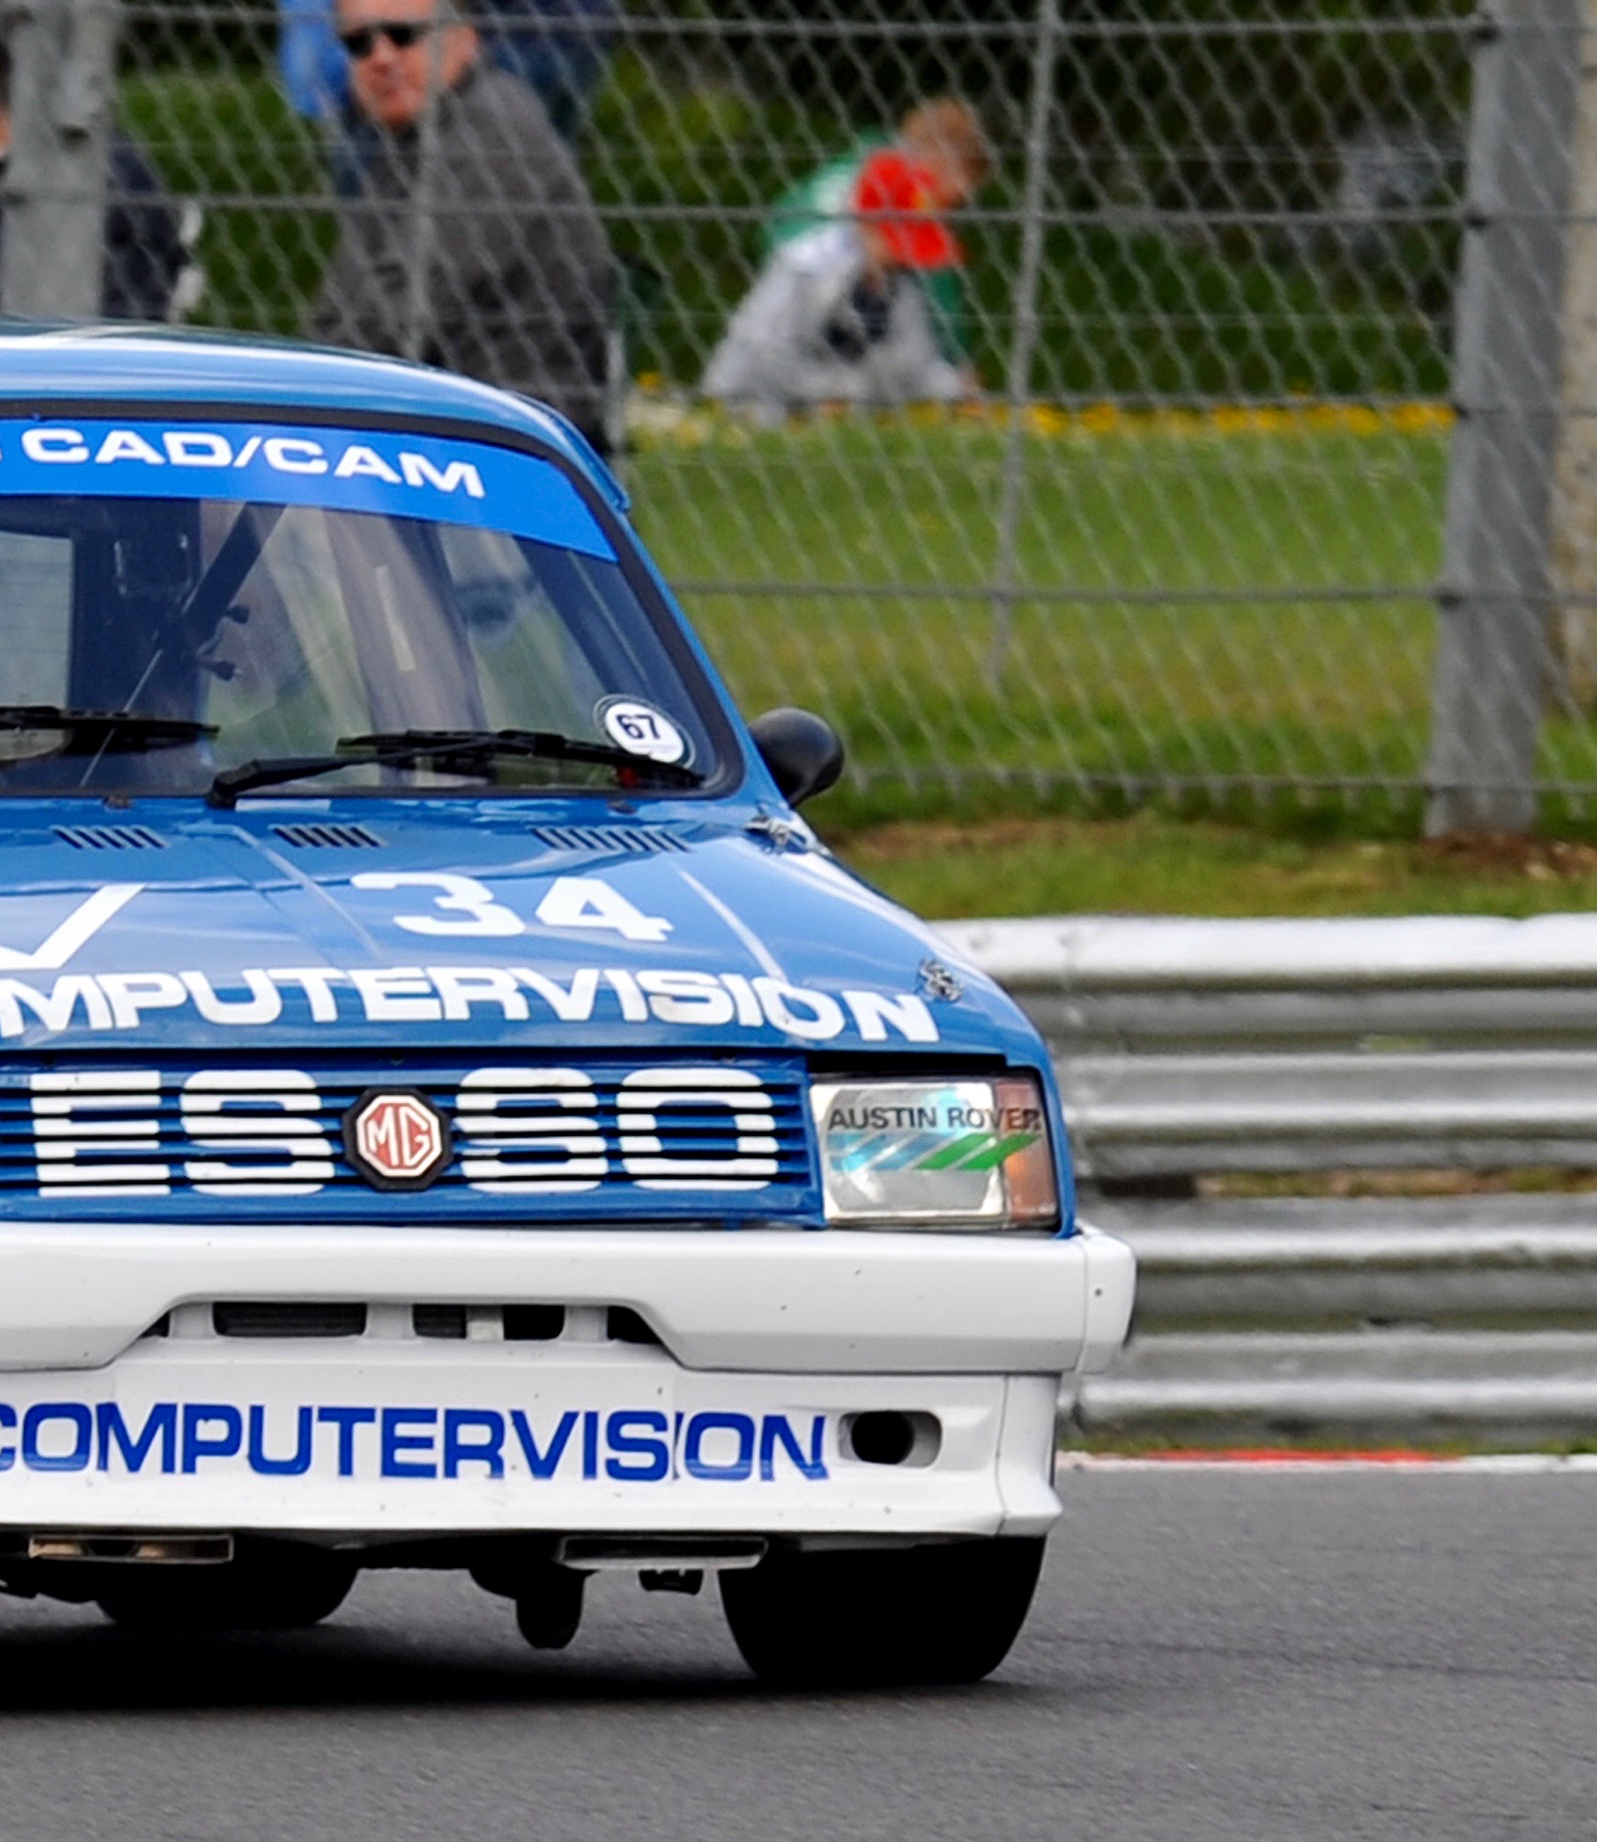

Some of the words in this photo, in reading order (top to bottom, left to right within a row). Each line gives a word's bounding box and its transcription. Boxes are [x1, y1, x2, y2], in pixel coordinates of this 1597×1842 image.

[22, 429, 486, 497] CAD/CAM
[616, 714, 660, 739] 67
[350, 871, 674, 942] 34
[366, 1105, 431, 1167] MG
[827, 1106, 939, 1131] AUSTIN
[947, 1107, 1043, 1132] ROVER
